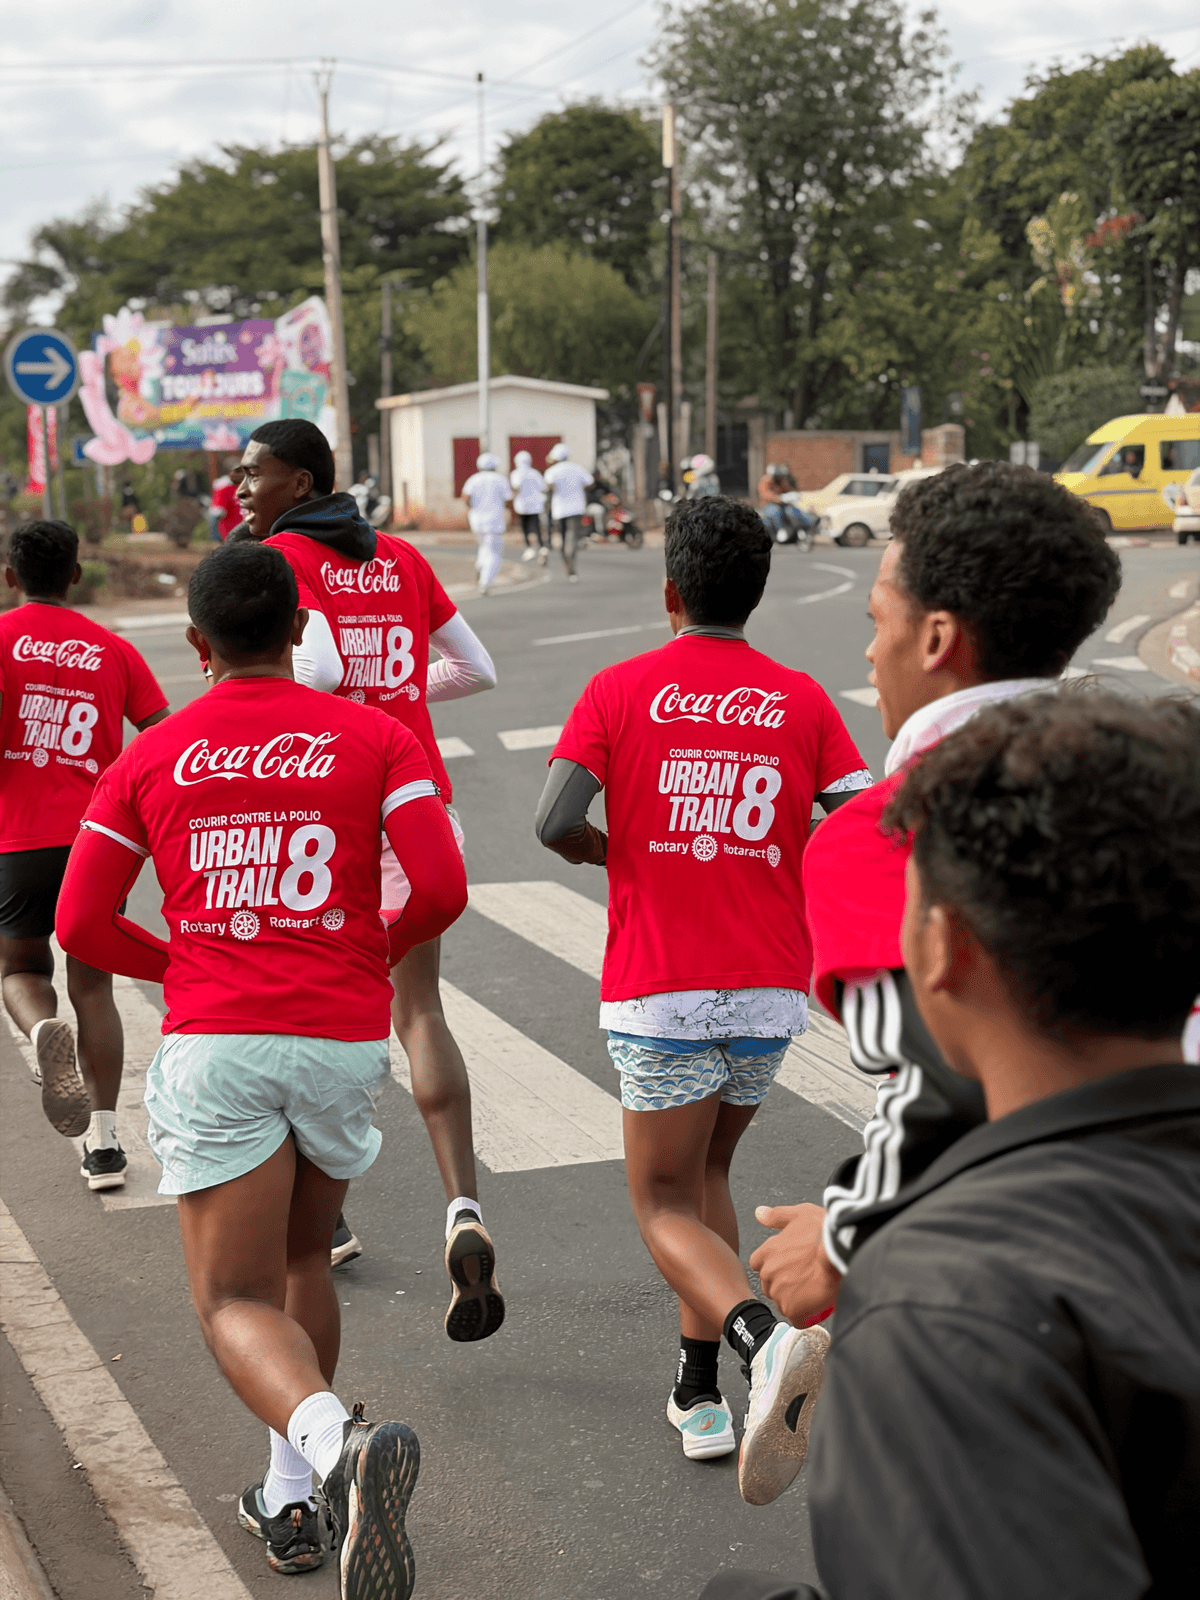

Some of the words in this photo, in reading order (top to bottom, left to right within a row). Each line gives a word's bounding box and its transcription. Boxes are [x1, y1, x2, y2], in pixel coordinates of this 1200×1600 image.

[320, 558, 401, 595] Coca-Cola
[13, 635, 105, 671] Coca-Cola
[339, 627, 383, 656] URBAN
[385, 626, 414, 688] 8
[343, 657, 386, 687] TRAIL
[19, 694, 69, 724] URBAN
[66, 689, 75, 697] LA
[76, 690, 95, 700] POLIO
[650, 683, 789, 728] Coca-Cola
[23, 720, 62, 751] TRAIL
[61, 702, 99, 757] 8
[4, 750, 31, 760] Rotary
[173, 732, 342, 786] Coca-Cola
[670, 749, 702, 758] COURIR
[704, 750, 738, 760] CONTRE
[741, 752, 751, 762] LA
[753, 754, 779, 766] POLIO
[658, 760, 739, 796] URBAN
[189, 815, 227, 829] COURIR
[230, 812, 271, 824] CONTRE
[274, 811, 287, 821] LA
[290, 811, 321, 821] POLIO
[669, 796, 732, 833] TRAIL
[732, 766, 782, 841] 8
[190, 826, 283, 871] URBAN
[649, 841, 689, 854] Rotary
[724, 844, 765, 858] Rotaract
[279, 824, 336, 911] 8
[203, 866, 278, 909] TRAIL
[180, 920, 226, 935] Rotary
[270, 916, 320, 928] Rotaract
